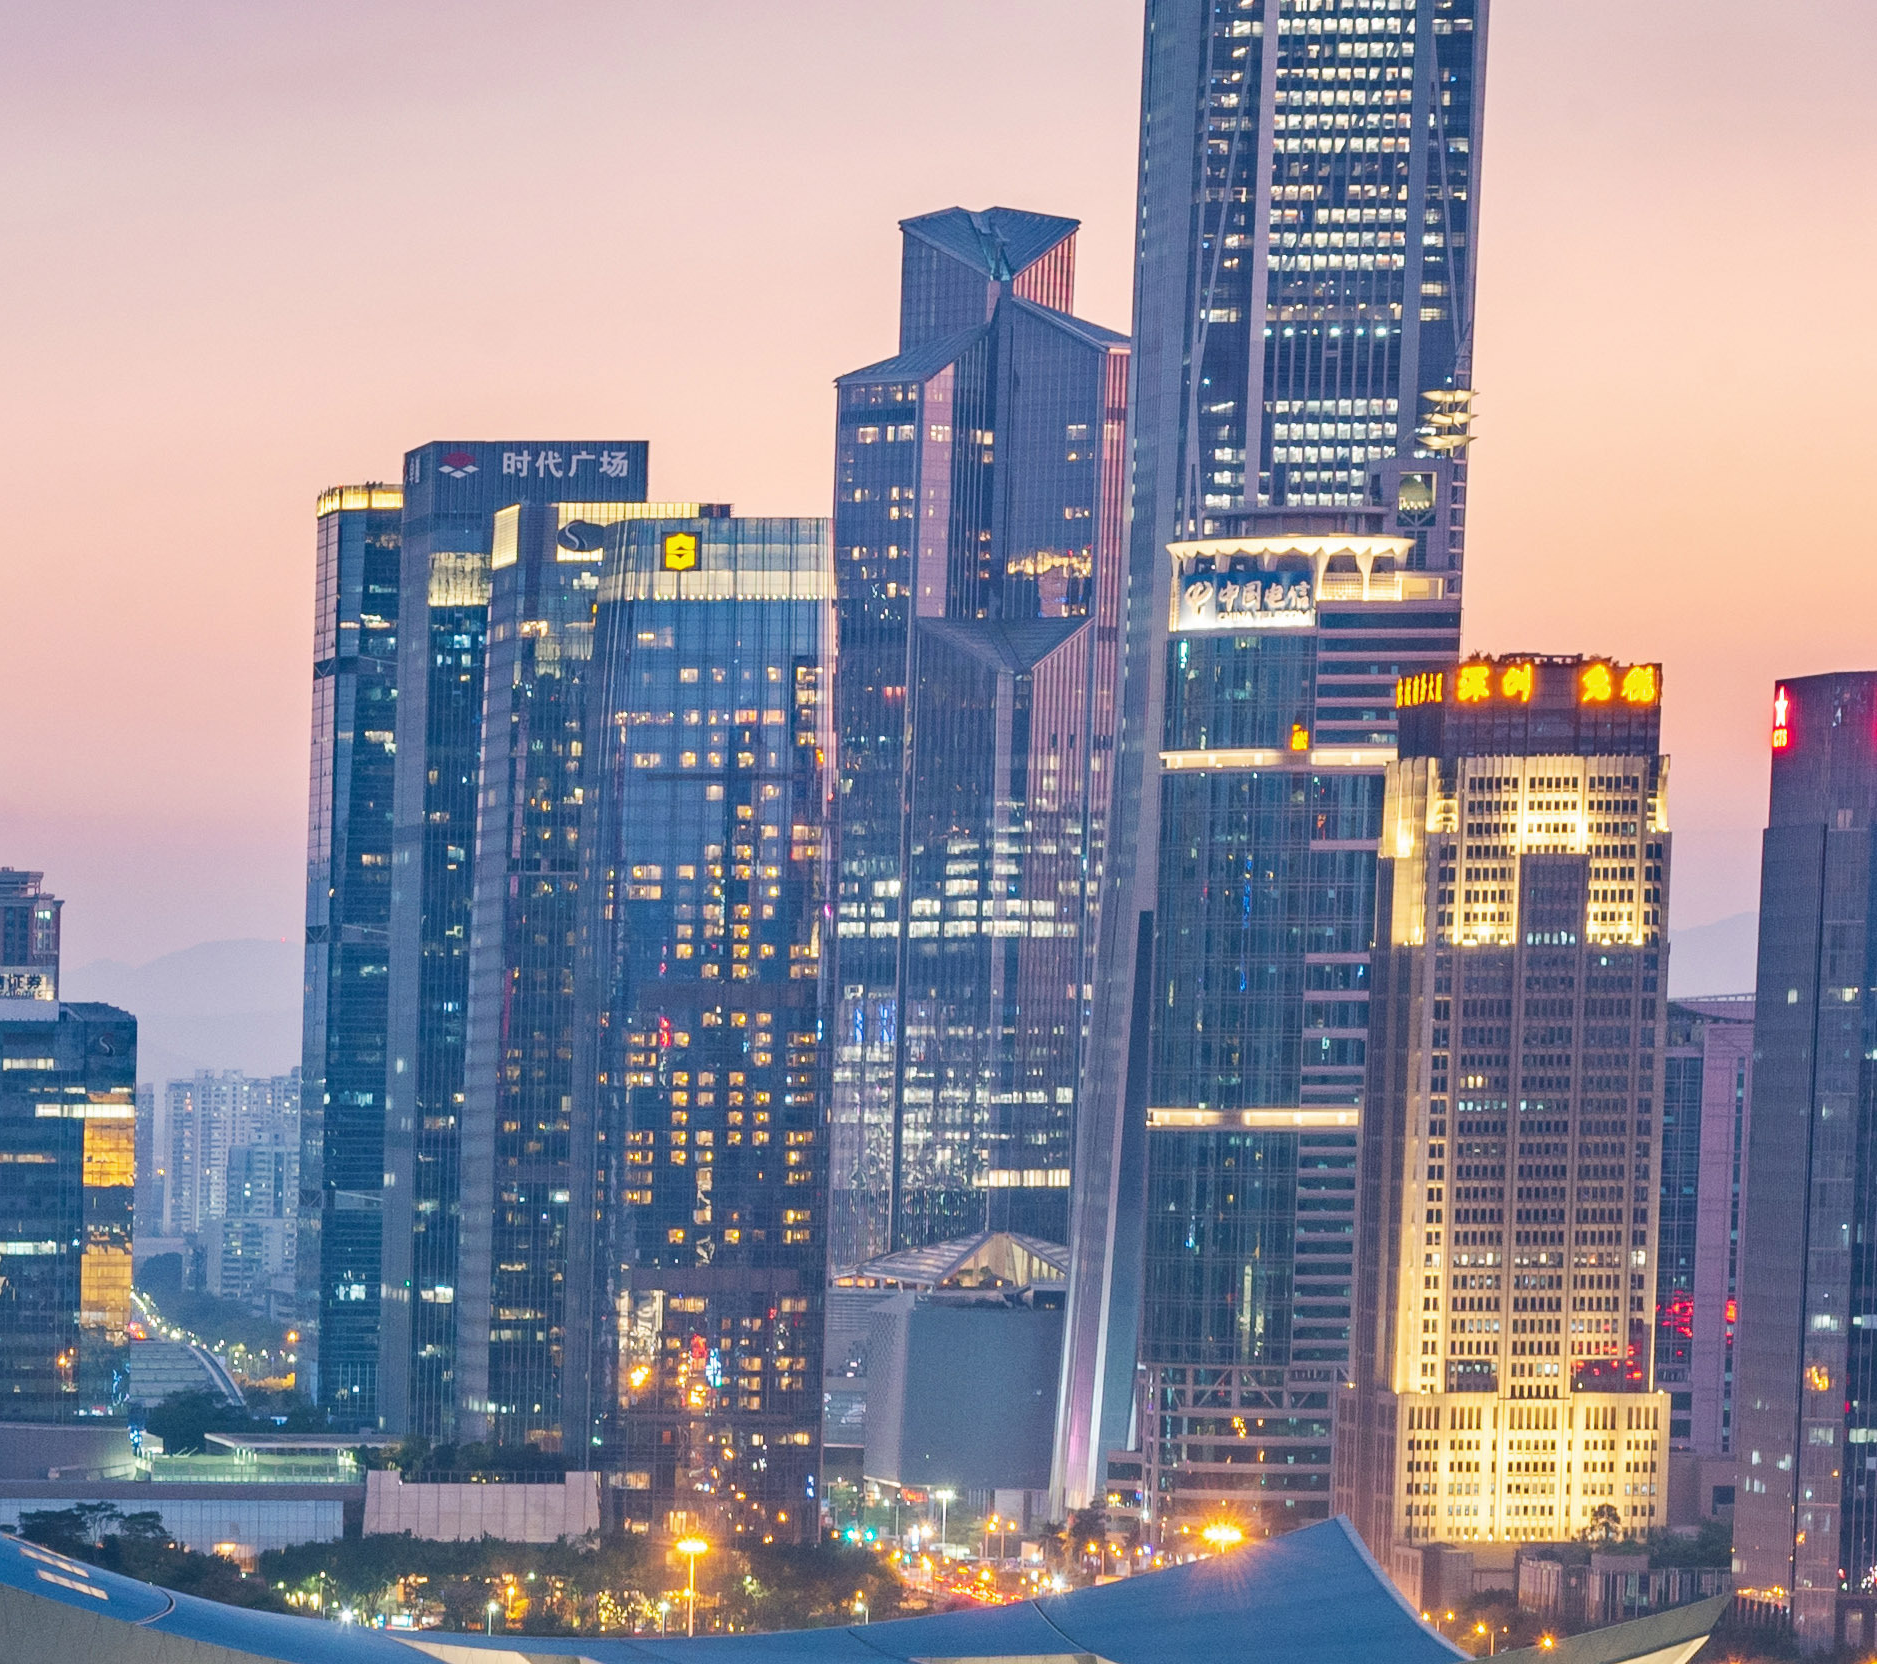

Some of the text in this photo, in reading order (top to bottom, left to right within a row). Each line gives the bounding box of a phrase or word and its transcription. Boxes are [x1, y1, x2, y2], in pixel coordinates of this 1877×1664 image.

[503, 450, 629, 478] 时代广场
[1218, 580, 1311, 612] 中国电信
[1218, 610, 1312, 622] CHINA TELECOM
